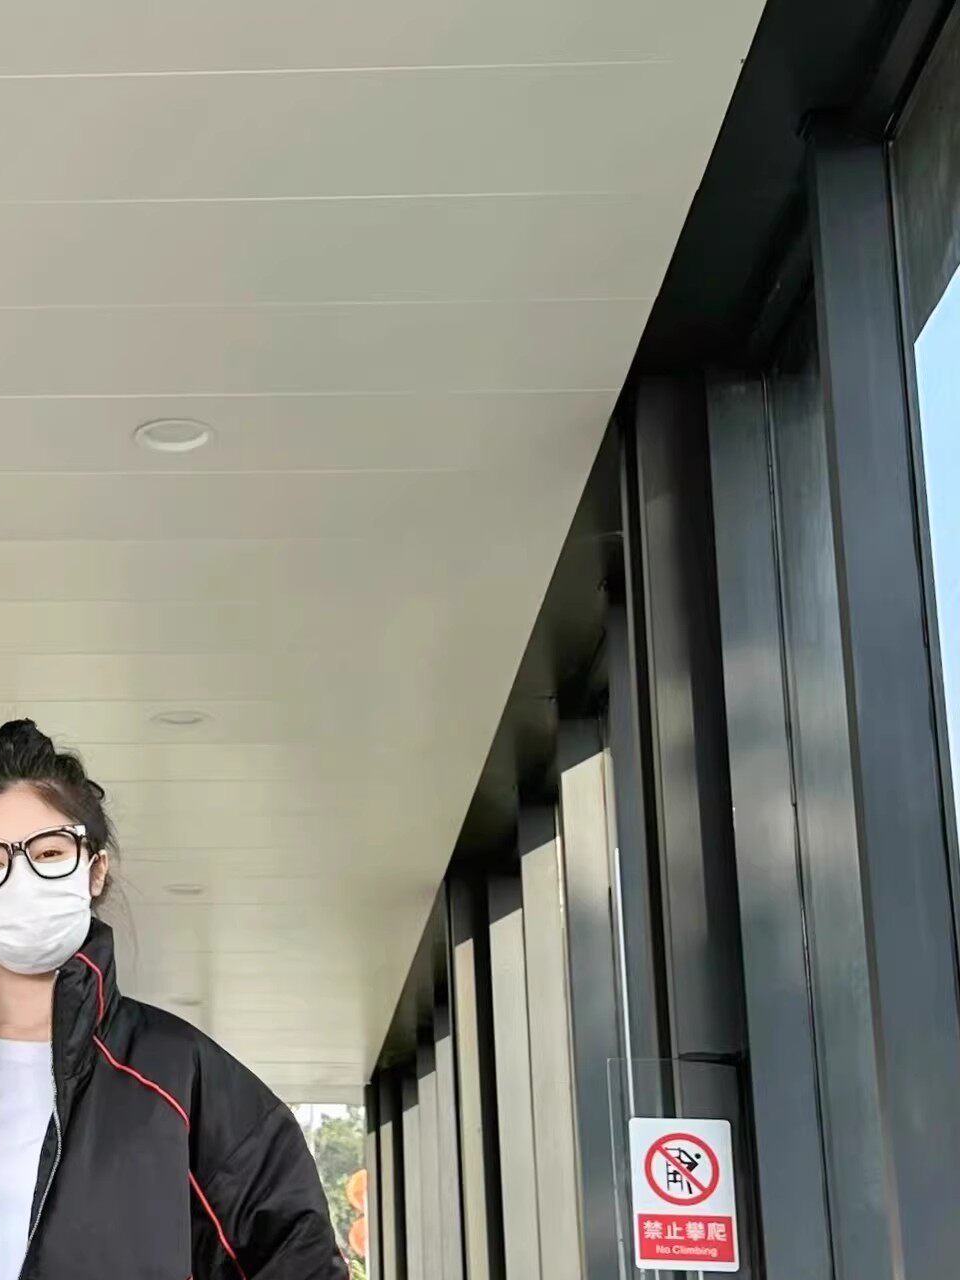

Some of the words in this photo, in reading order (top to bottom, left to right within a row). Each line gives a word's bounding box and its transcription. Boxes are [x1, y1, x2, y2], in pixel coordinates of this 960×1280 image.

[643, 1220, 727, 1241] 禁止攀爬
[656, 1244, 671, 1254] No
[672, 1245, 718, 1258] Climbing
